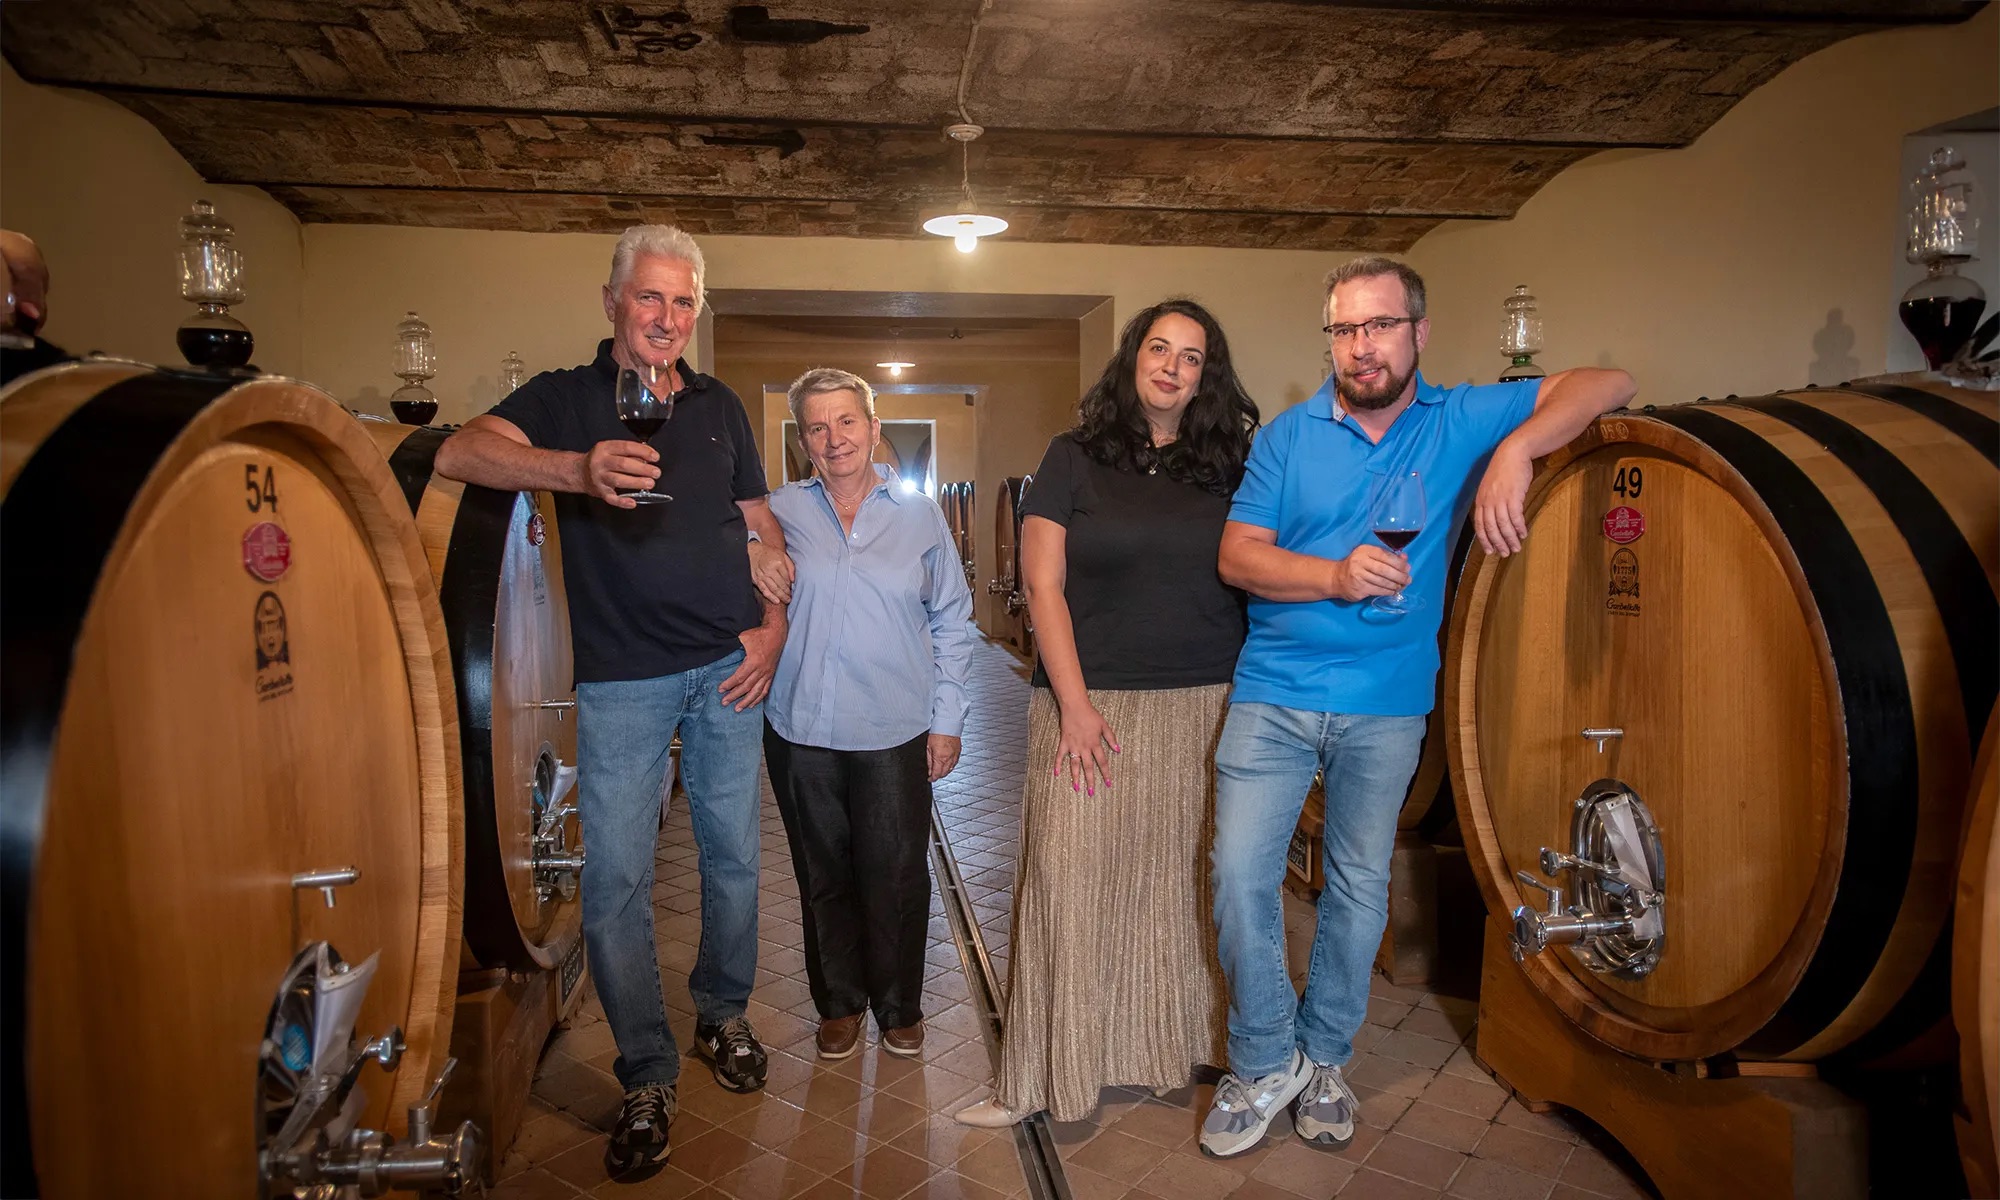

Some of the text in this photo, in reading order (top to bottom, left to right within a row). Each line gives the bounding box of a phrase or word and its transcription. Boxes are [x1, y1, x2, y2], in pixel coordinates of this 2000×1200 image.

[245, 464, 278, 513] 54
[1613, 466, 1643, 499] 49
[1616, 566, 1632, 575] 1775
